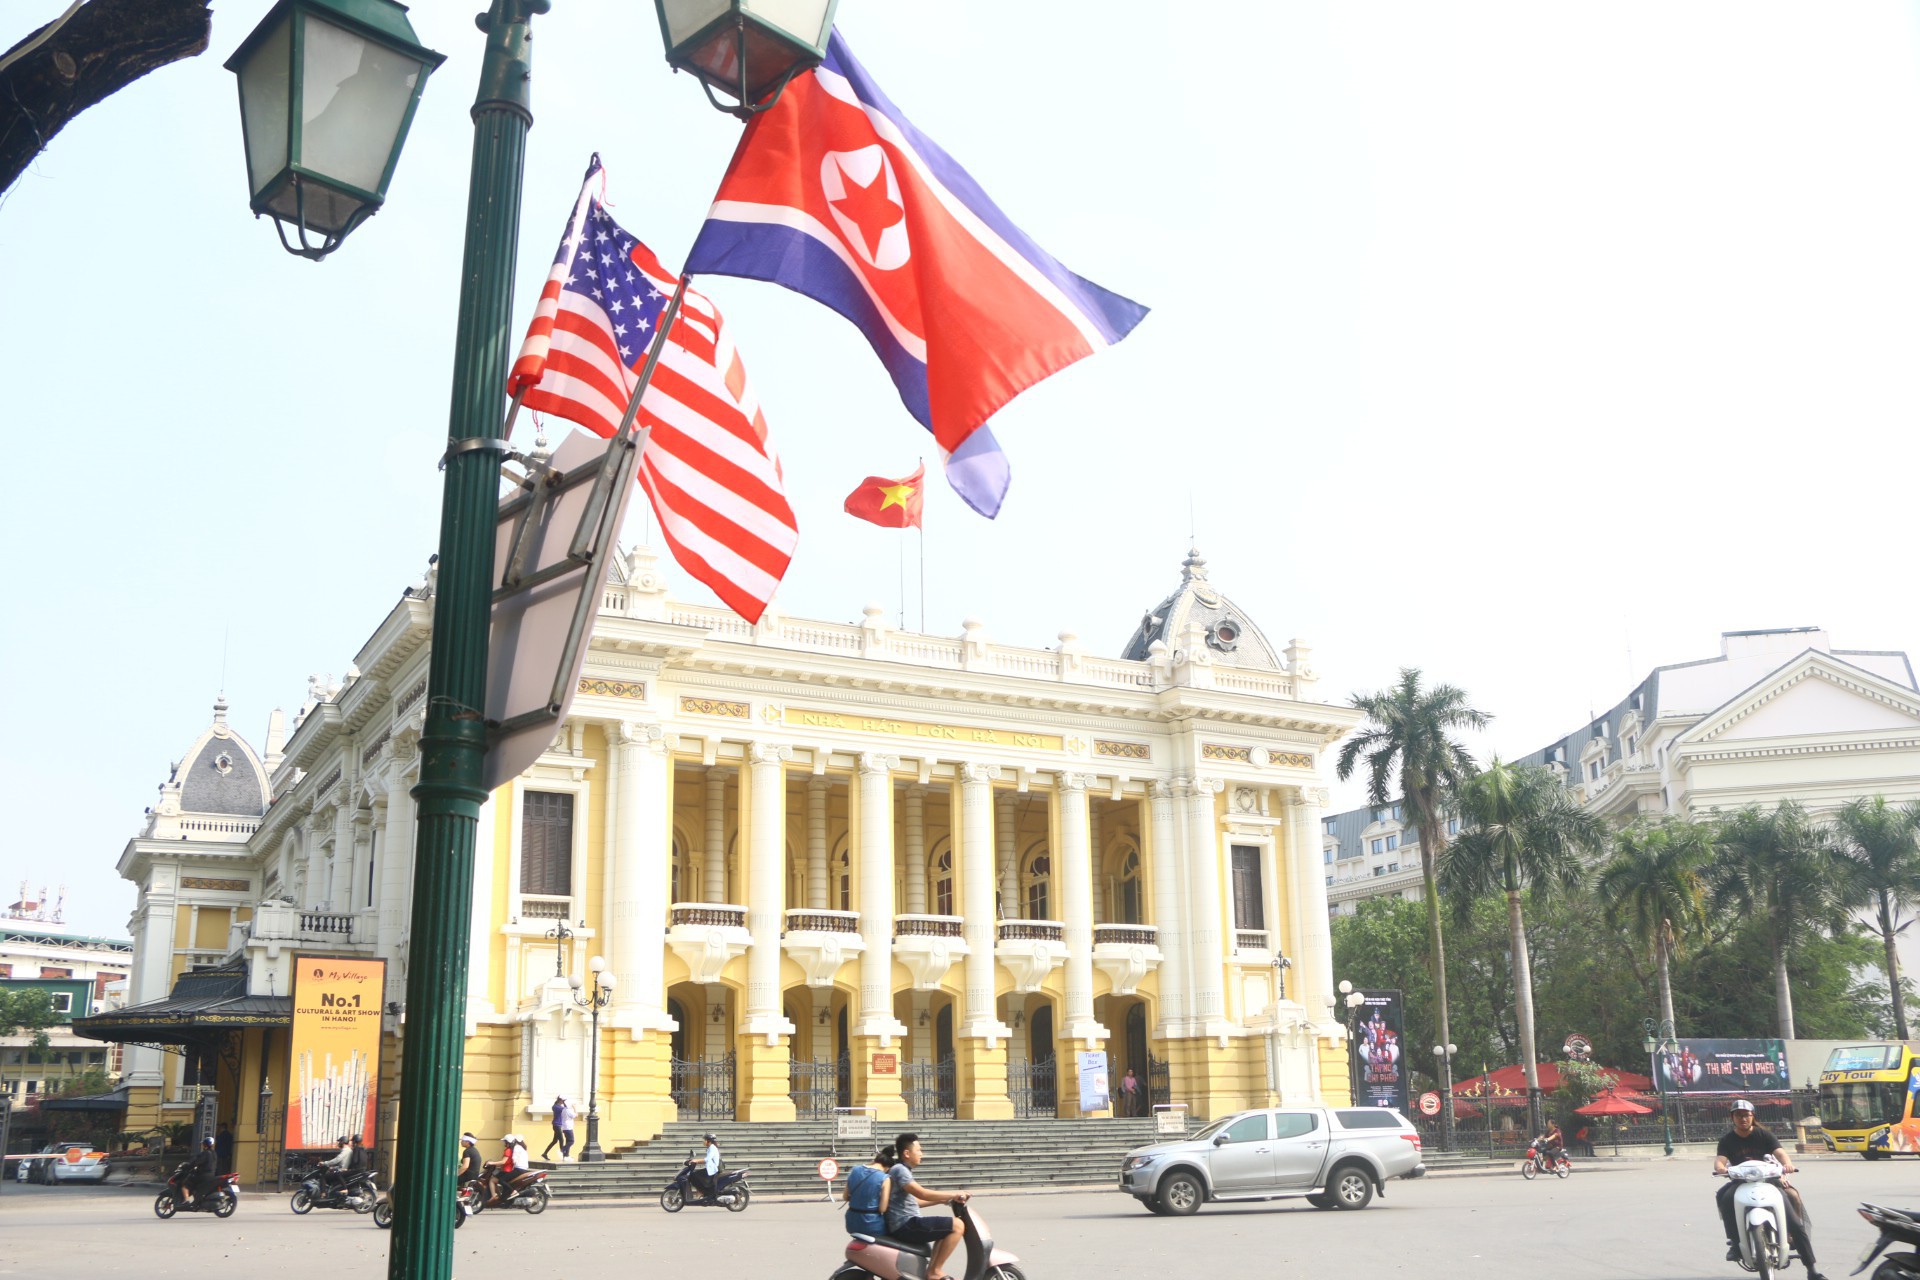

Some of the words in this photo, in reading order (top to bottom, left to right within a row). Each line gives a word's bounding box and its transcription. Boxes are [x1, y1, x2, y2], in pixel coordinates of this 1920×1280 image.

[802, 713, 846, 728] NHÀ
[862, 717, 902, 734] HÁT
[343, 972, 368, 984] Village
[321, 993, 361, 1008] No.1
[1820, 1072, 1840, 1082] City
[1843, 1071, 1875, 1080] Tour
